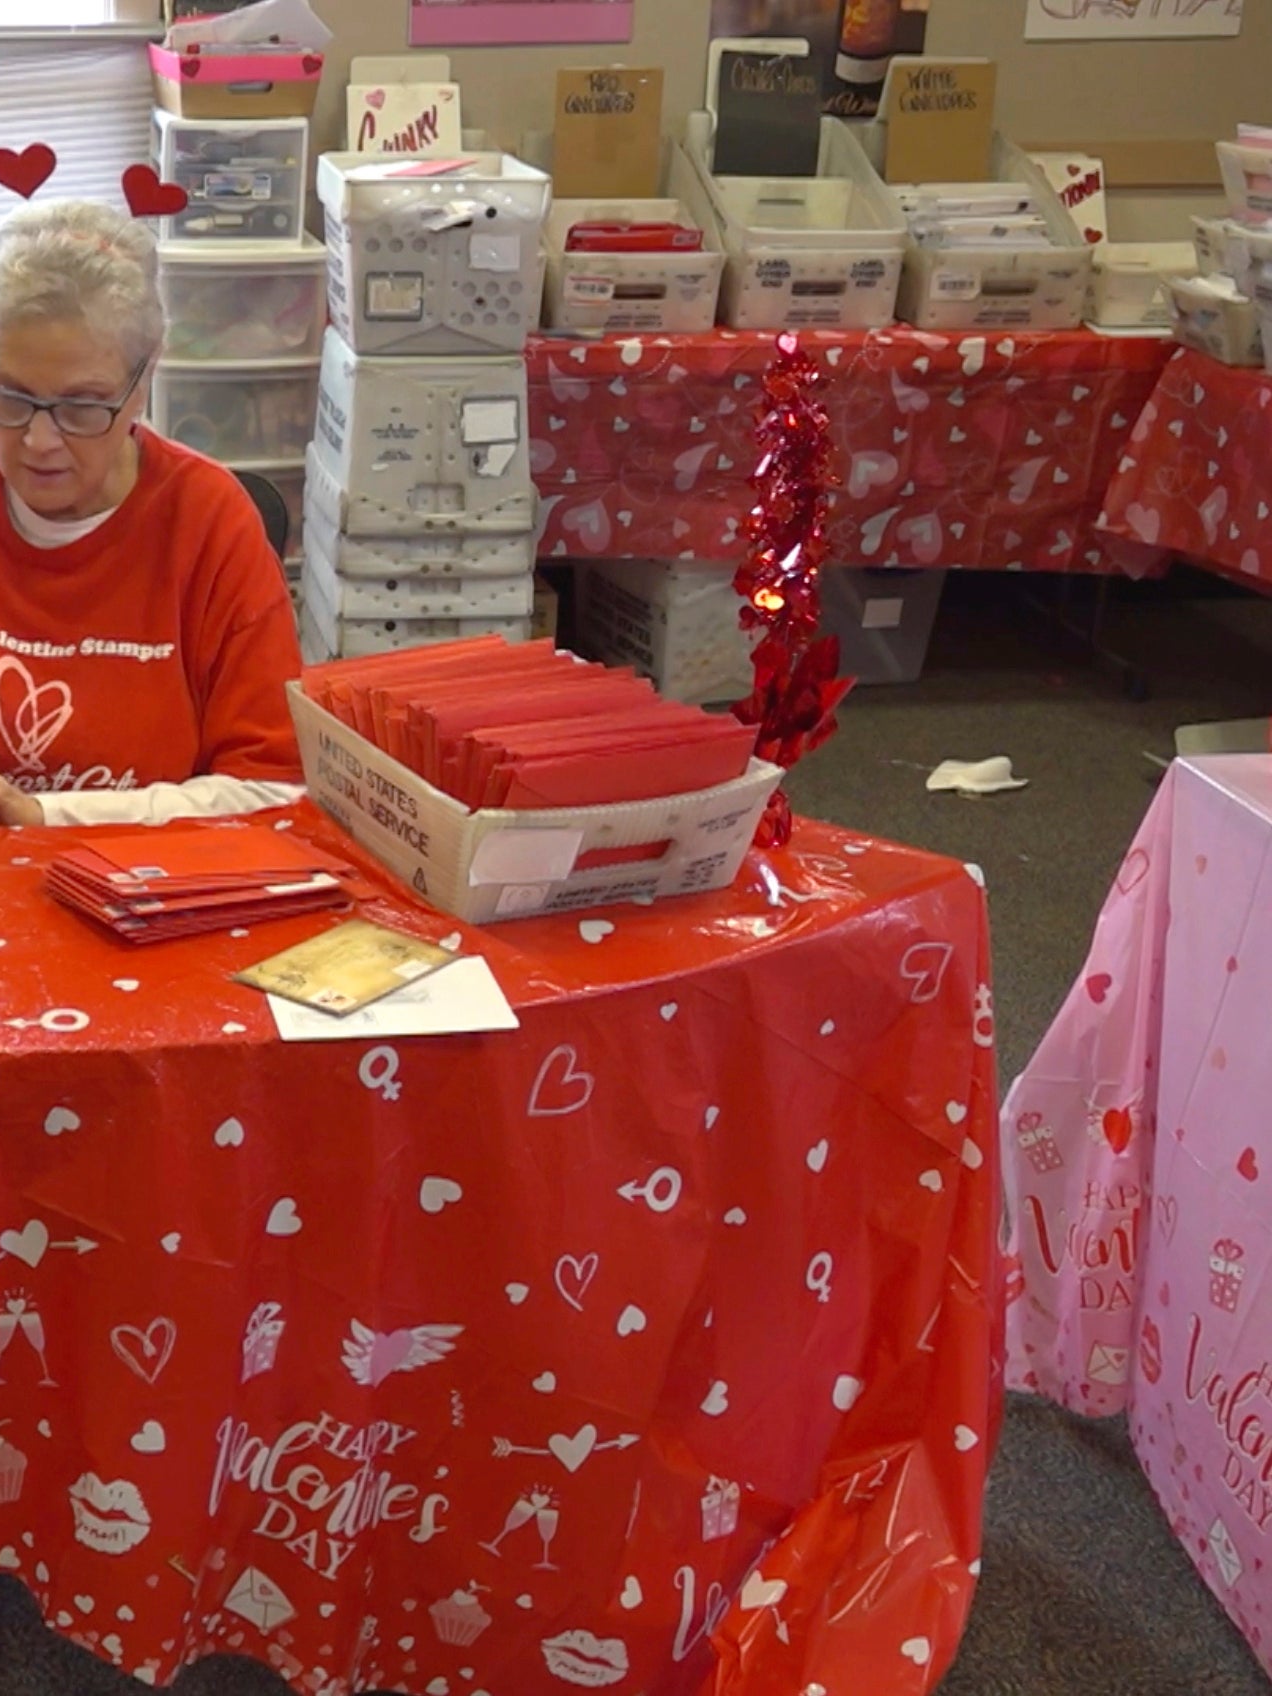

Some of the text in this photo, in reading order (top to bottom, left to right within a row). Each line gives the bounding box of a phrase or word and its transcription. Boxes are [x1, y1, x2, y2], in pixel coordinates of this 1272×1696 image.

[79, 636, 176, 663] Stamper
[317, 756, 365, 811] POSTAL
[369, 796, 430, 858] SERVICE
[318, 728, 363, 780] UNITED
[366, 766, 419, 820] STATES
[1080, 1276, 1133, 1312] DA
[252, 1497, 357, 1581] DAY
